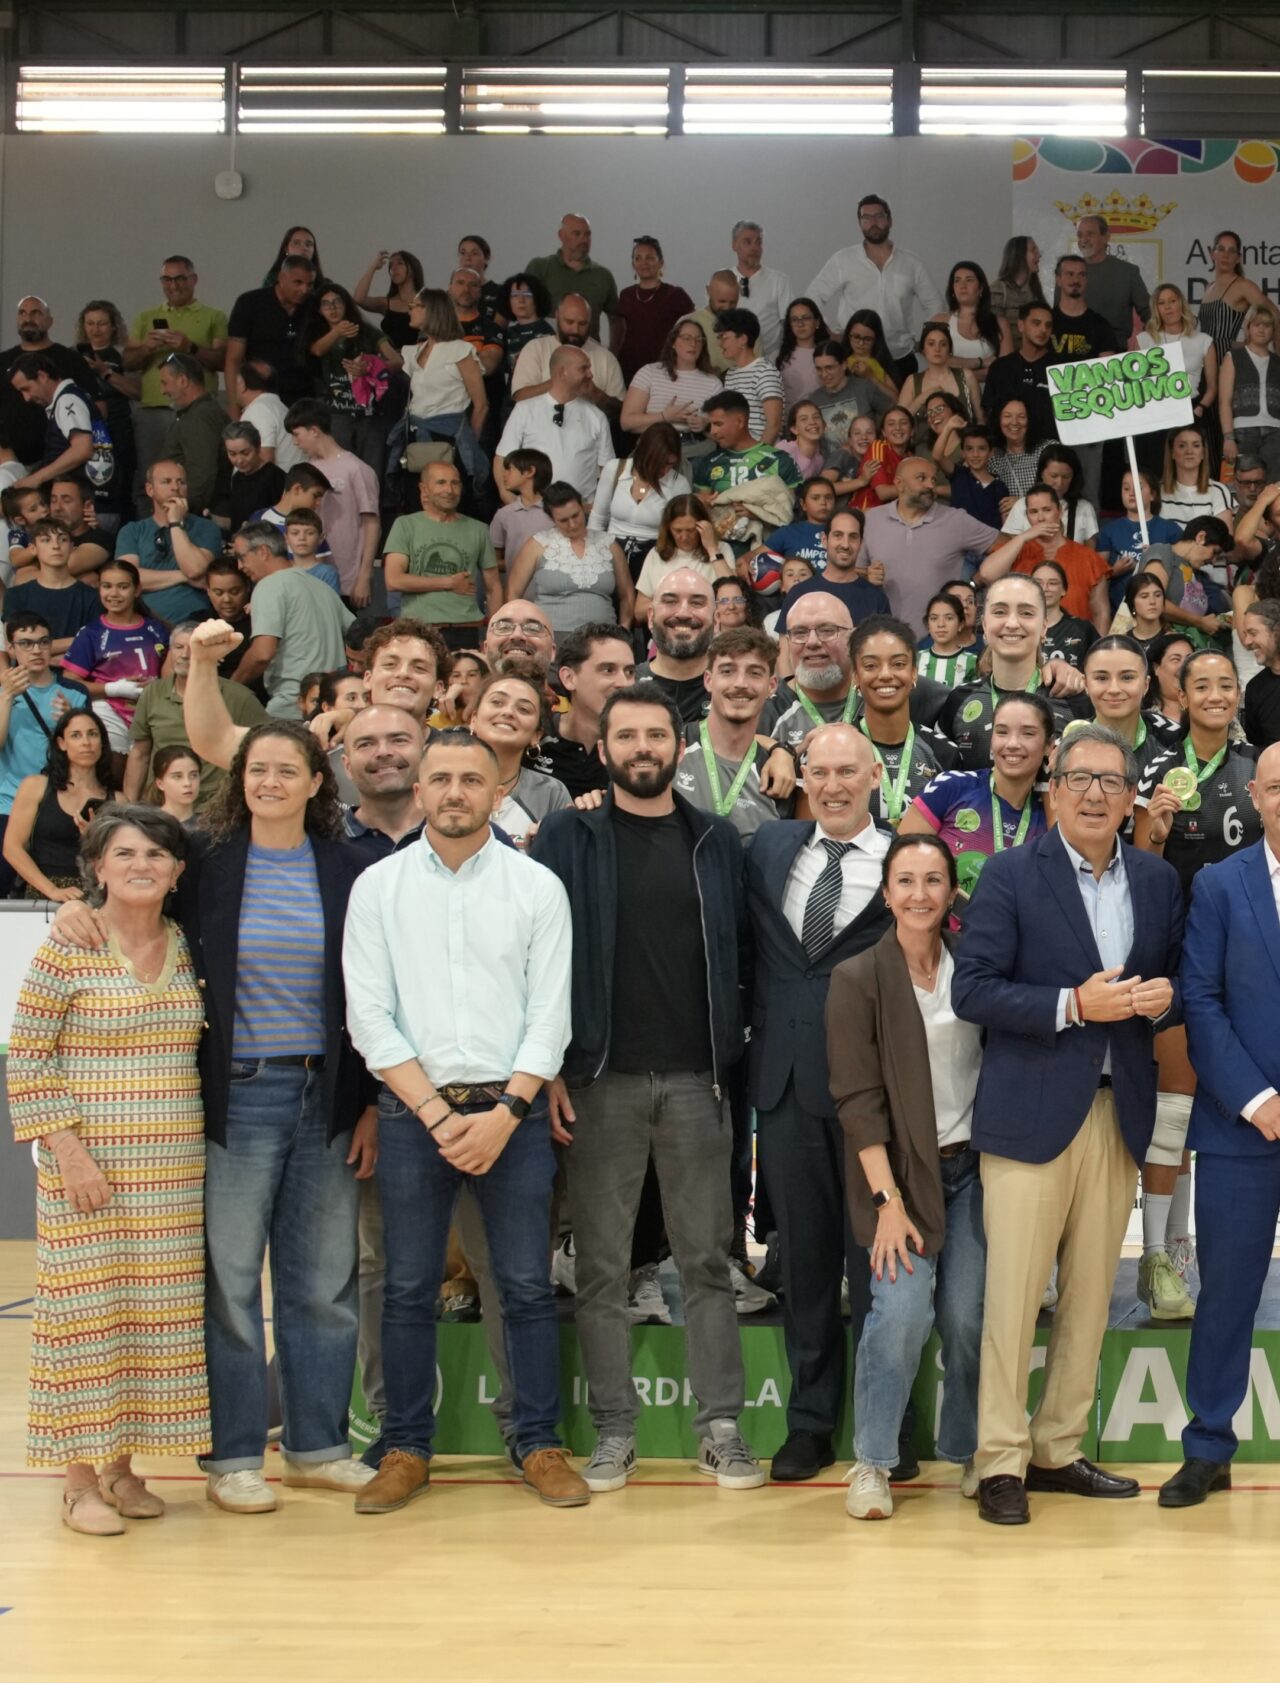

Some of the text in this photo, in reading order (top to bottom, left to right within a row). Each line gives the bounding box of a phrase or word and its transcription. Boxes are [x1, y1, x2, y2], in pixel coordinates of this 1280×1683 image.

[1048, 347, 1170, 393] VAMOS
[1052, 371, 1192, 421] ESQUIMO
[1223, 805, 1244, 847] 6
